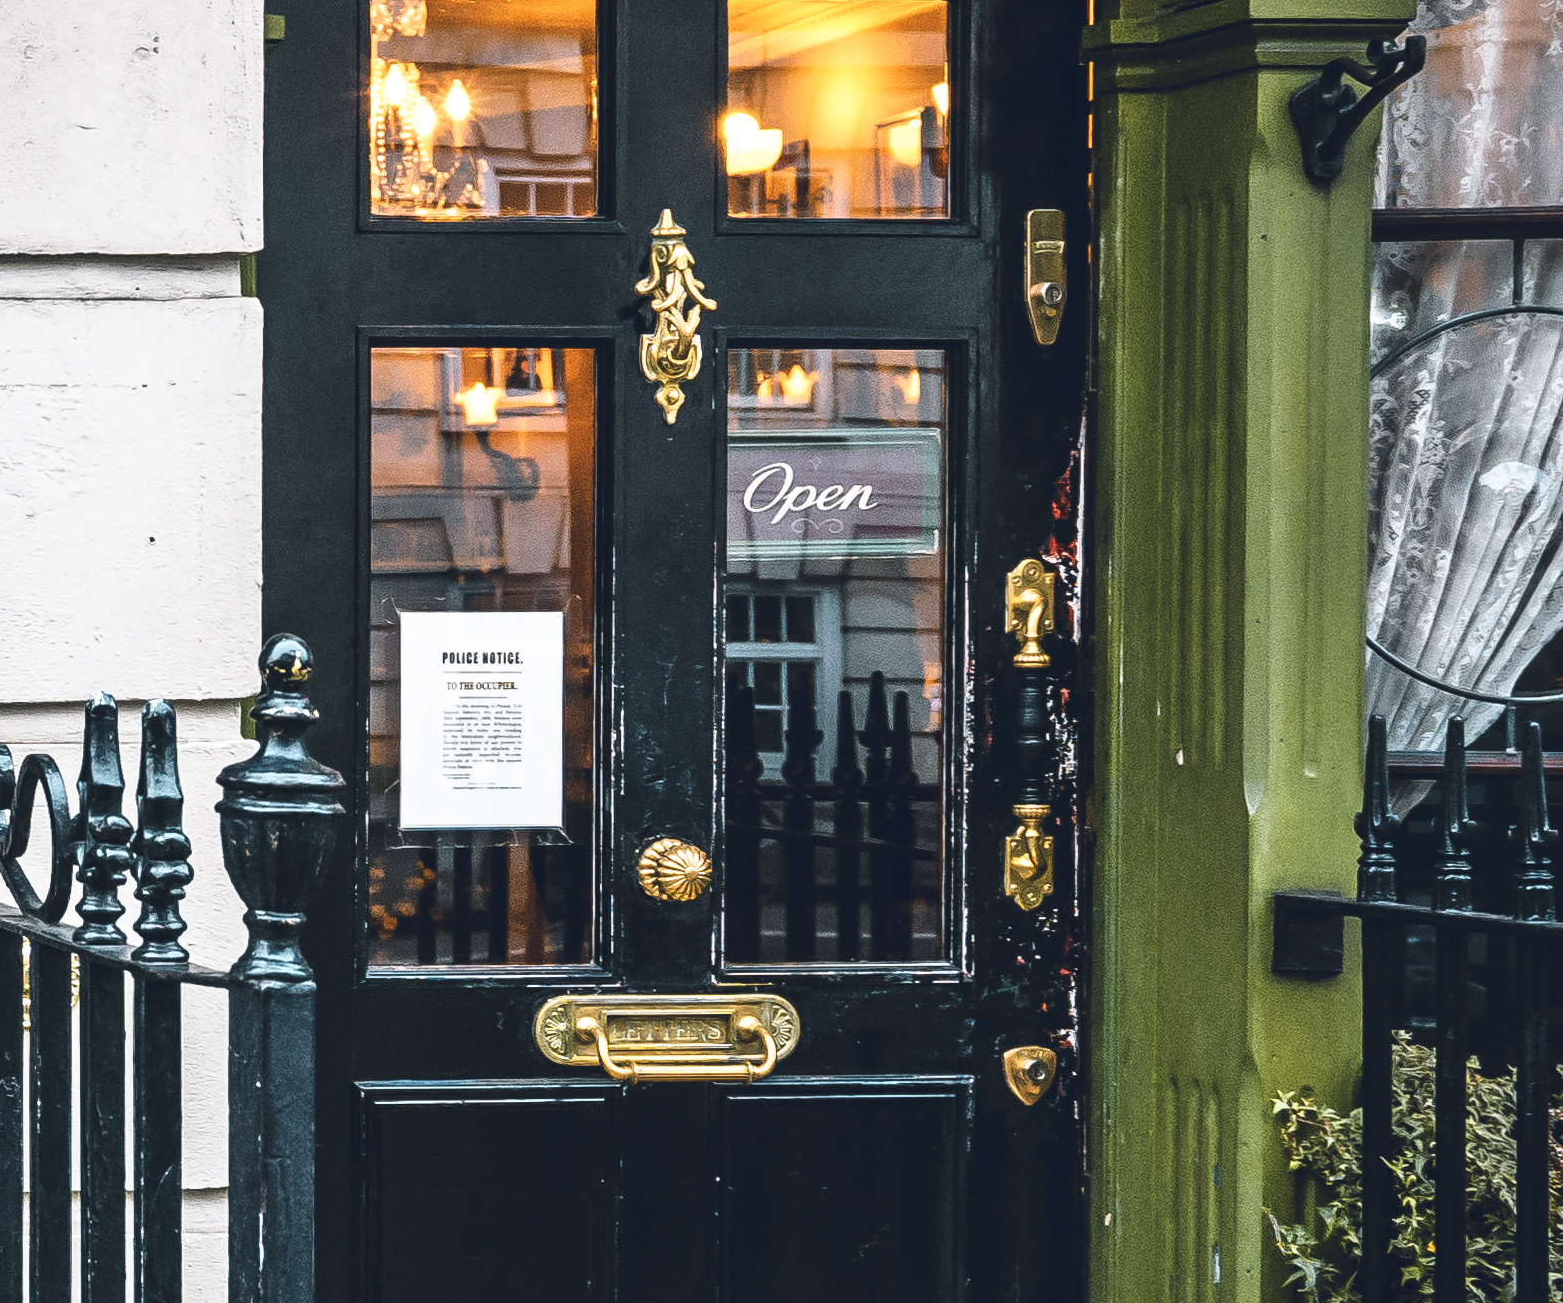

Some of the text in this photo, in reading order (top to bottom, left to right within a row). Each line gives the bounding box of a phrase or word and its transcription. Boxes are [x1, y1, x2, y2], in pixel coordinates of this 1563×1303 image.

[743, 462, 879, 525] Open
[442, 652, 524, 665] POLICE NOTICE.
[447, 682, 458, 690] TO
[459, 682, 474, 690] THE
[611, 1019, 722, 1042] LETTERS
